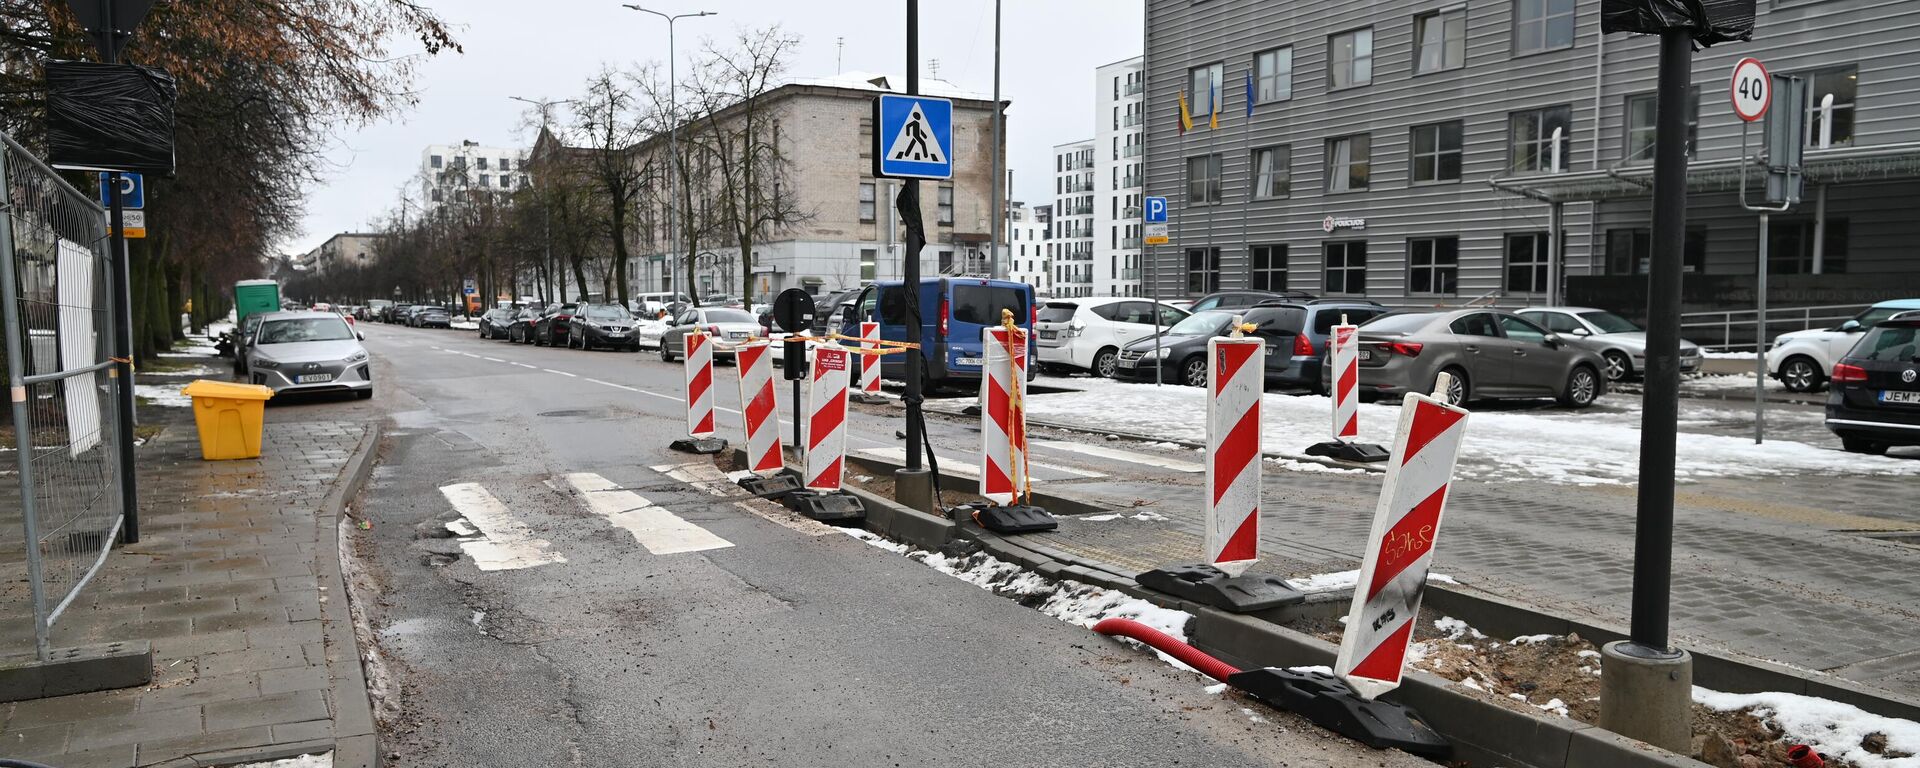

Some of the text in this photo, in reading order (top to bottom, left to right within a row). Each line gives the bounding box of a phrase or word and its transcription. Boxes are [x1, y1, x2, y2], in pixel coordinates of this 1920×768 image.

[1739, 77, 1762, 101] 40
[1151, 200, 1163, 220] P
[1885, 391, 1911, 401] JEM
